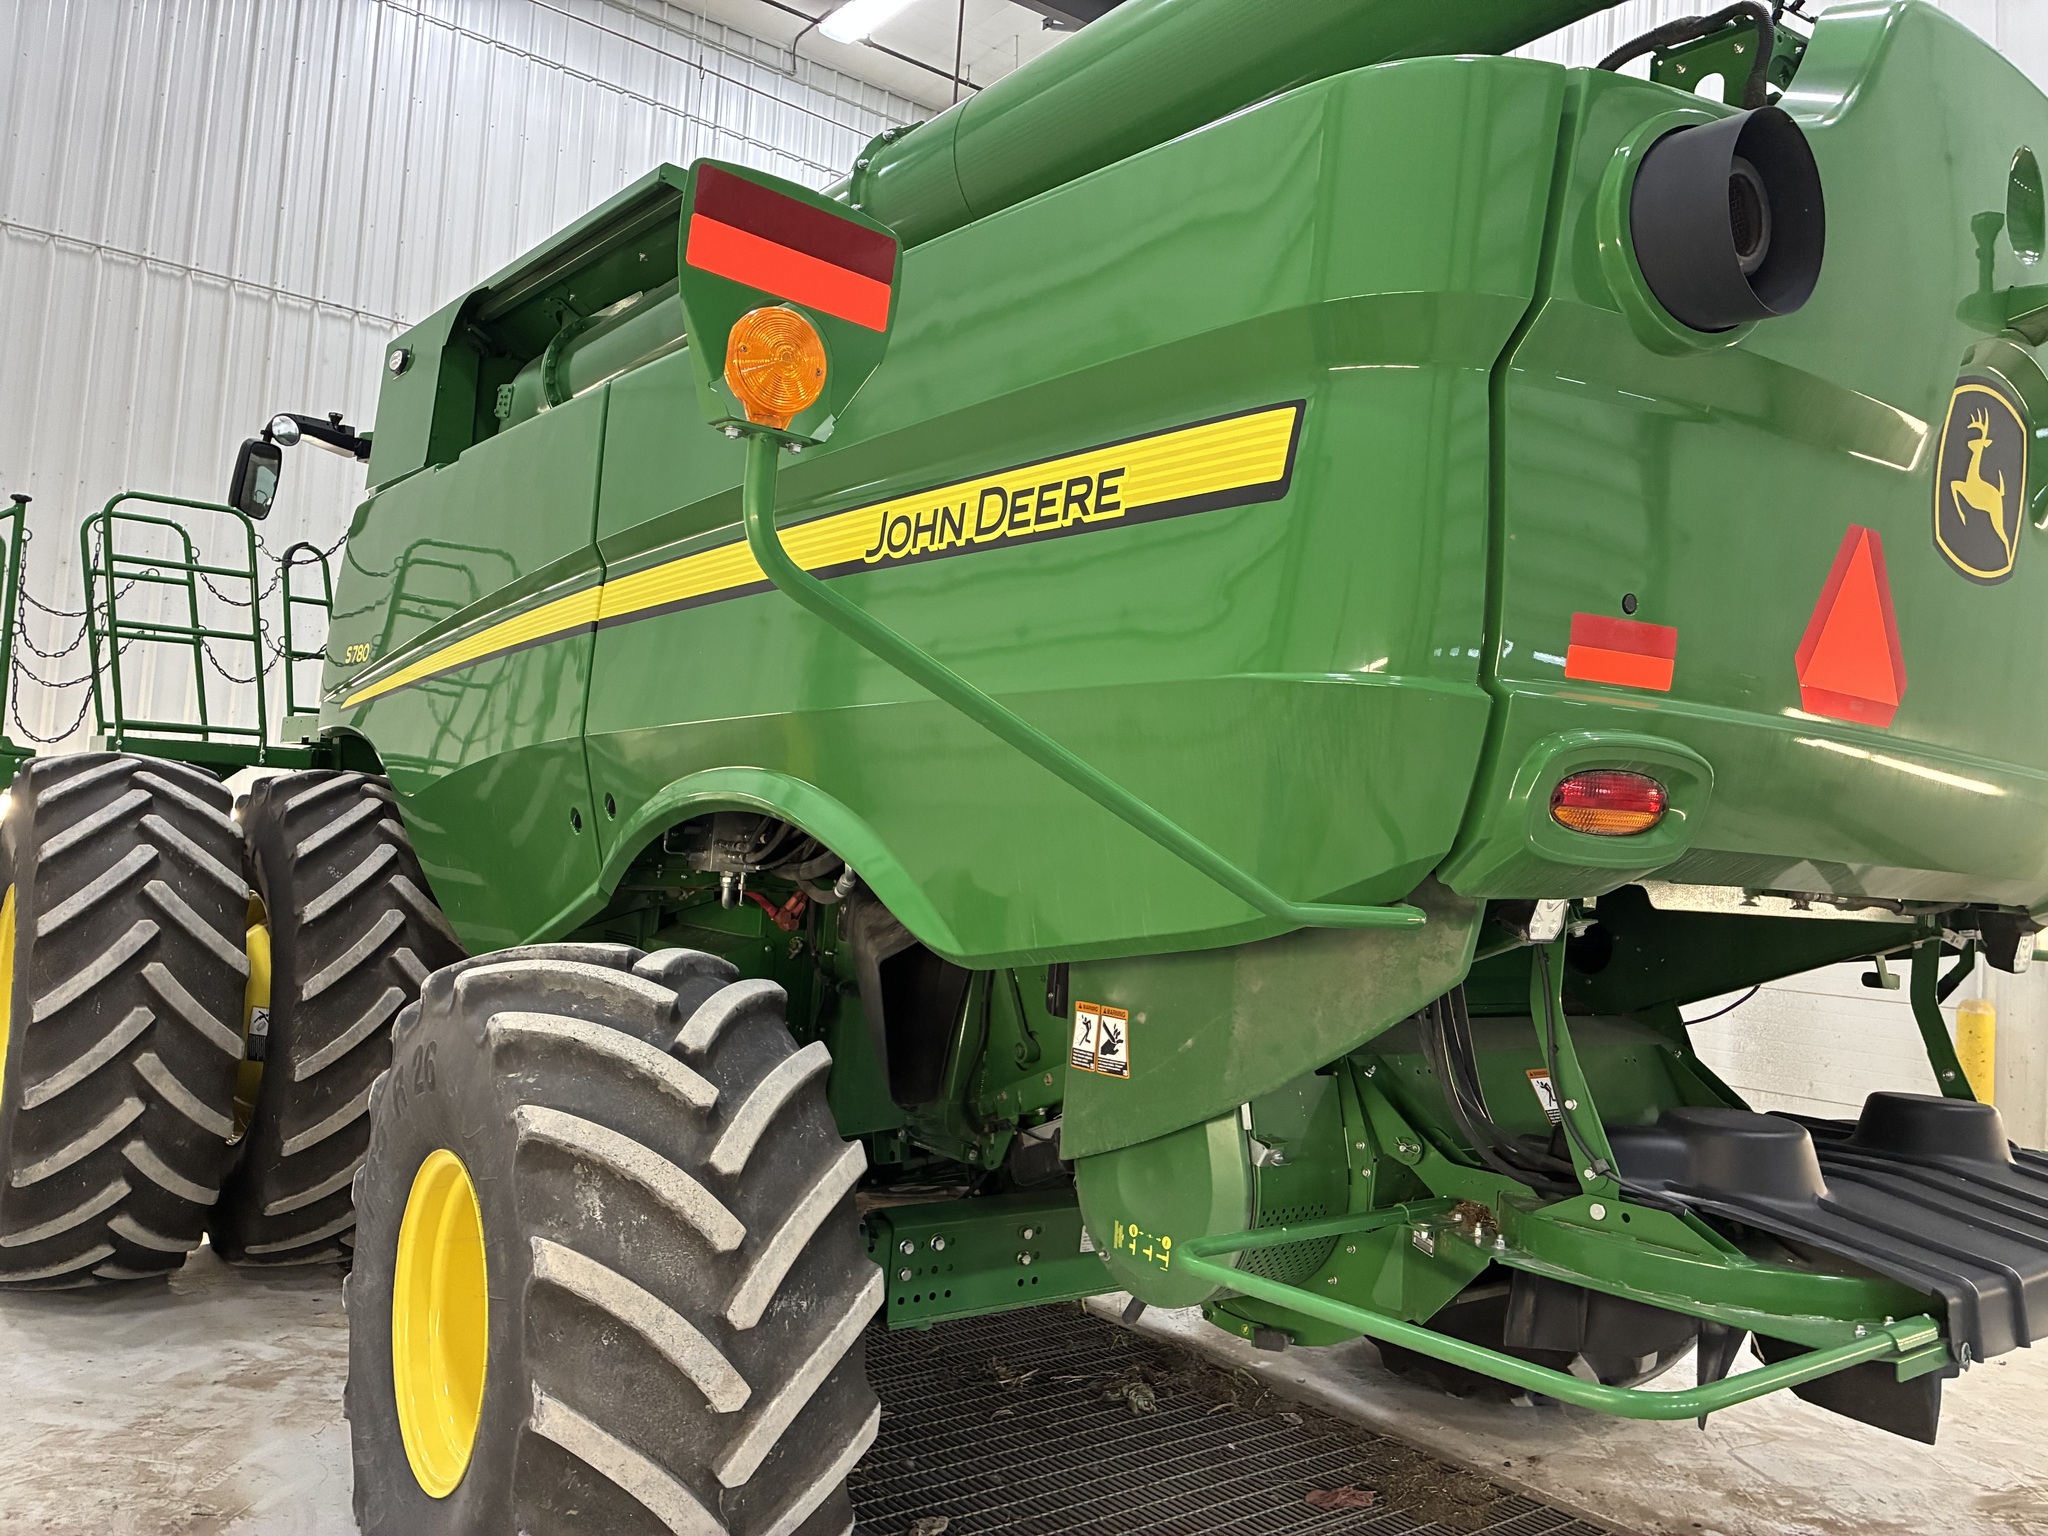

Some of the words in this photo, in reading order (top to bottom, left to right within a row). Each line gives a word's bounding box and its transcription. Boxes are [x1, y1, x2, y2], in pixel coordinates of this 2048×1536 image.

[865, 503, 966, 558] JOHN
[974, 467, 1125, 537] DEERE
[345, 642, 370, 664] S780
[1106, 1009, 1126, 1018] WARNING
[412, 1041, 436, 1093] 26
